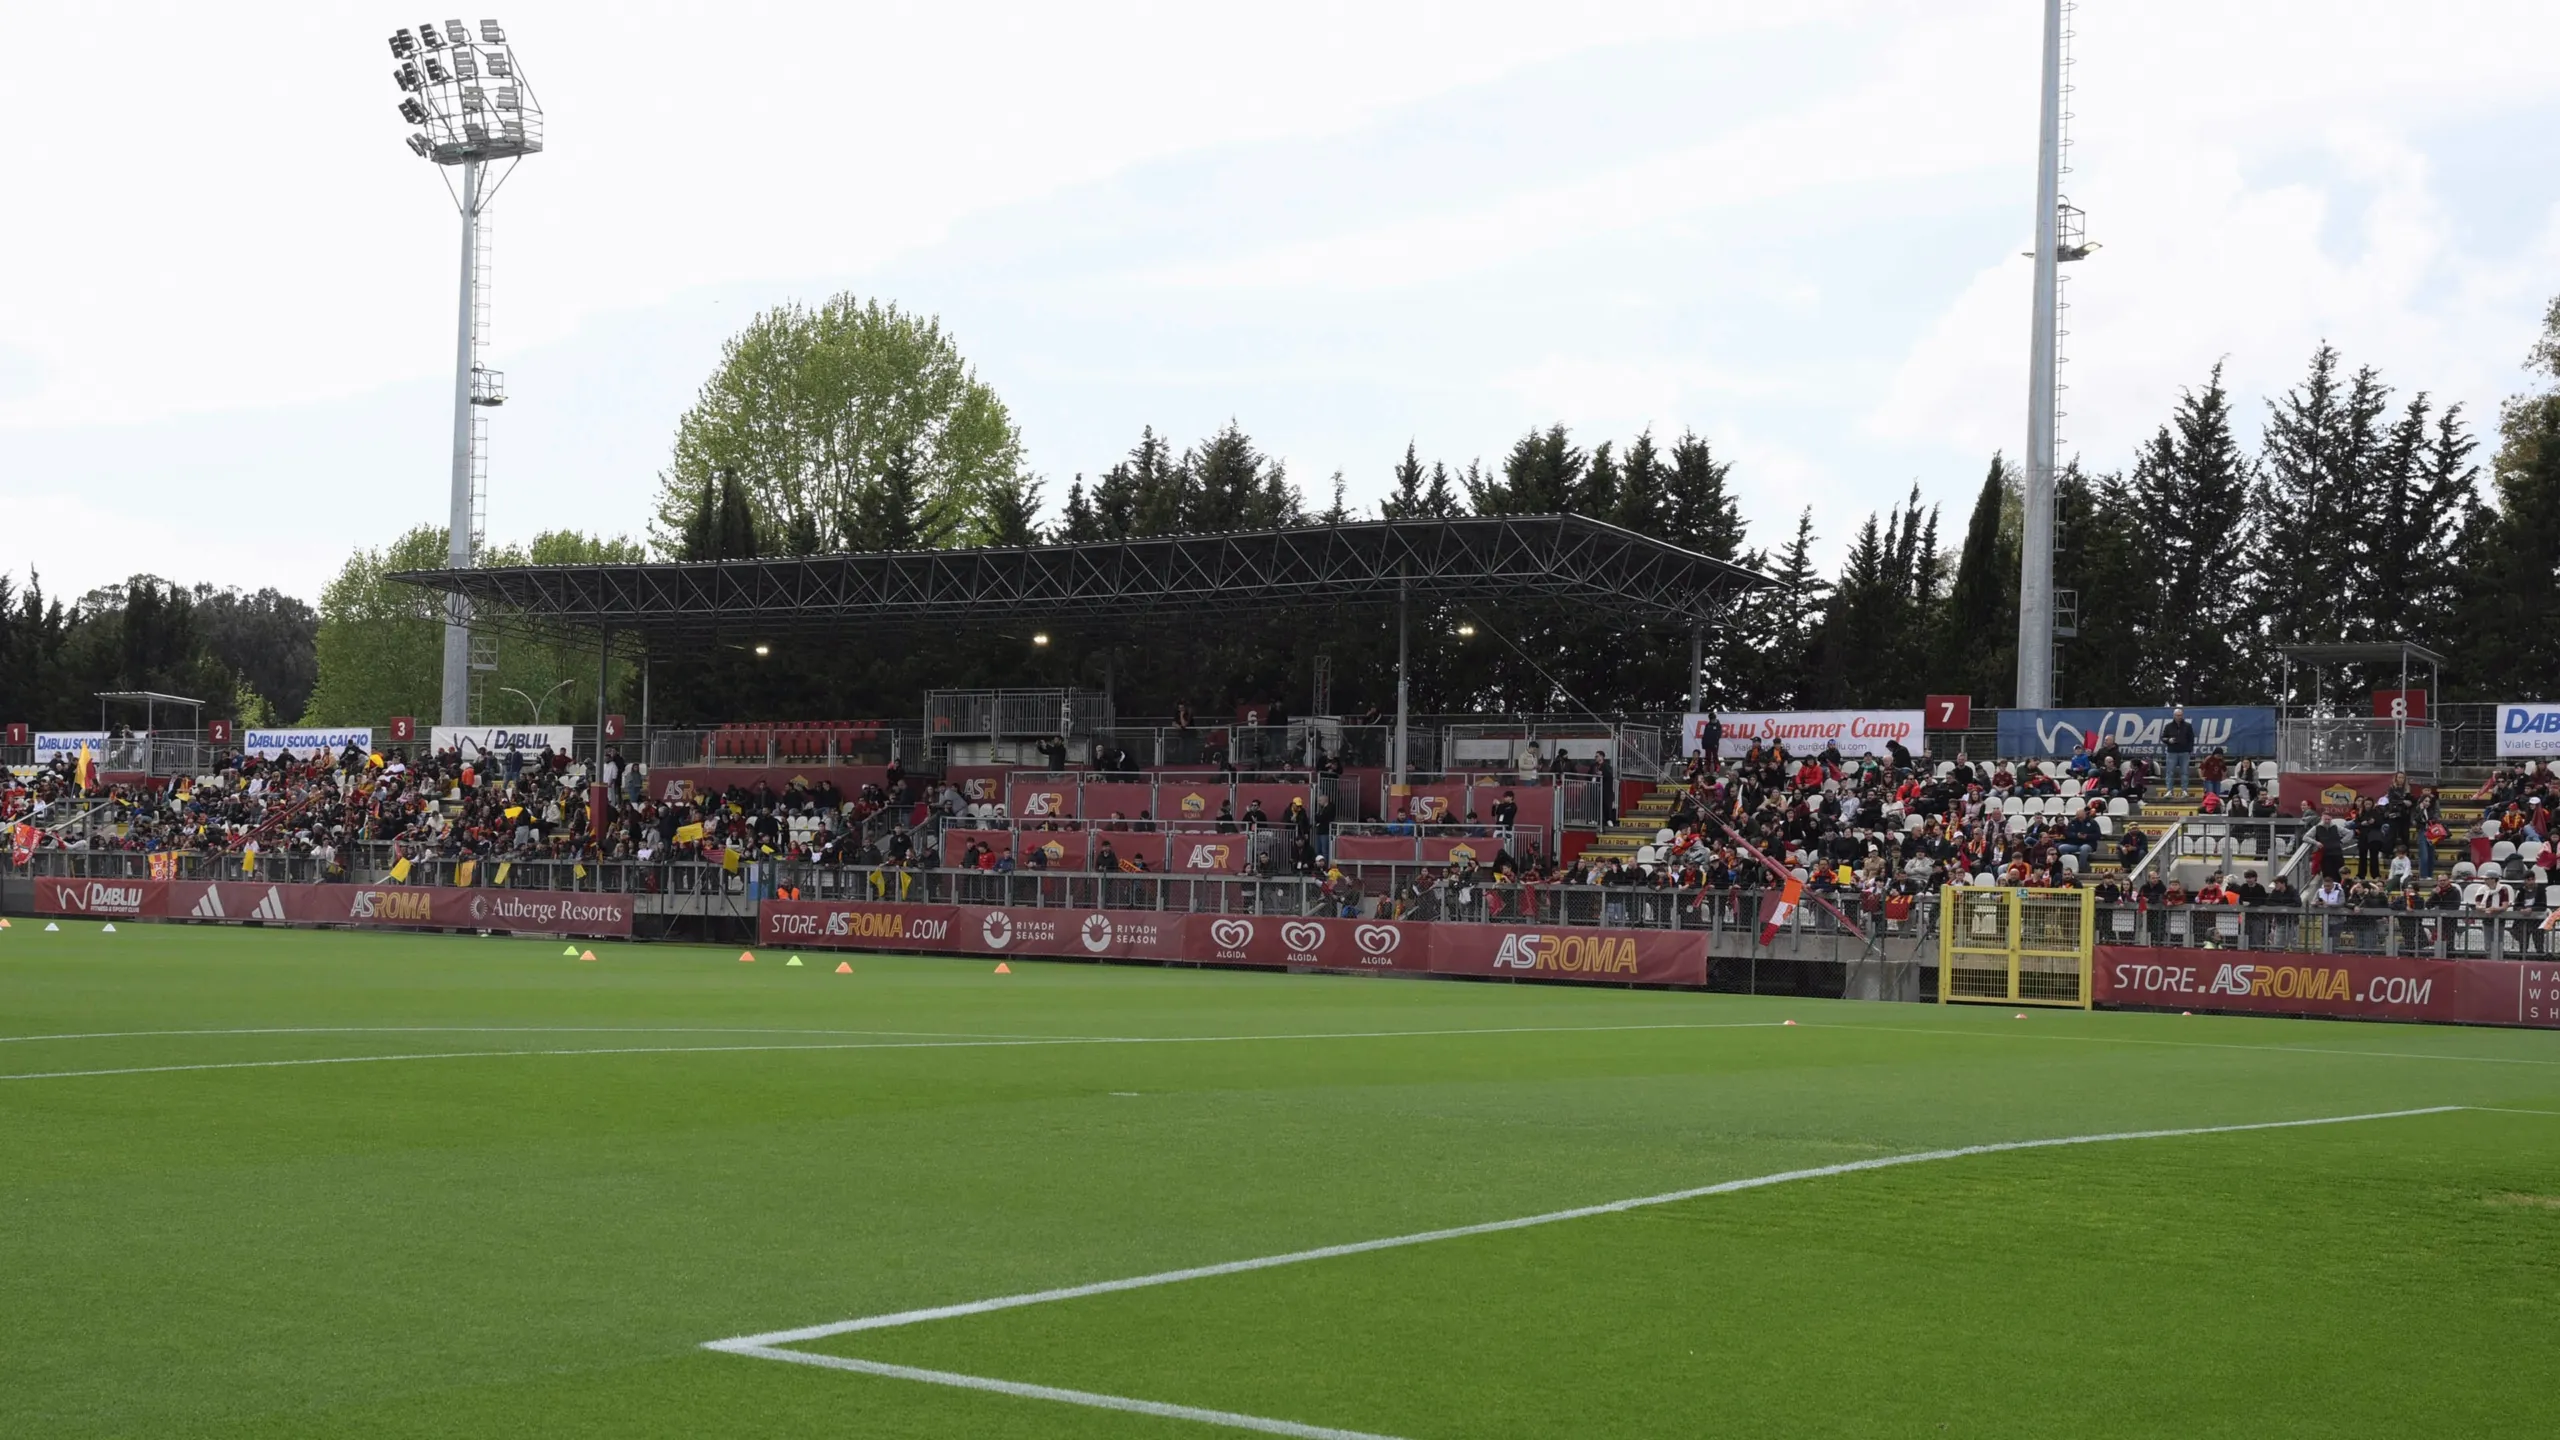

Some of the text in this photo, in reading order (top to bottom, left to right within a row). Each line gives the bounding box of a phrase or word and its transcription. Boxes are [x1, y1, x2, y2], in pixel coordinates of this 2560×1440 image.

[1941, 702, 1954, 722] 7
[2391, 698, 2407, 720] 8
[13, 728, 19, 741] 1
[215, 725, 223, 739] 2
[398, 721, 405, 736] 3
[605, 720, 614, 735] 4
[1695, 716, 1910, 742] DBLIU Summer Camp
[2116, 713, 2232, 744] DAIU
[2118, 745, 2154, 754] ITNESS
[2505, 740, 2531, 748] Viale
[663, 780, 695, 799] ASR
[964, 778, 997, 799] ASR
[1024, 793, 1062, 815] ASR
[1187, 844, 1229, 868] ASR
[91, 883, 142, 906] DABLIU
[492, 897, 622, 924] Auberge Resorts
[1016, 922, 1055, 930] RIYADH
[1117, 924, 1157, 934] RIYADH
[1016, 932, 1054, 940] SEASON
[1116, 935, 1156, 944] SEASON
[1216, 951, 1247, 959] ALGIDA
[1287, 954, 1317, 962] ALGIDA
[1361, 956, 1392, 965] ALGIDA
